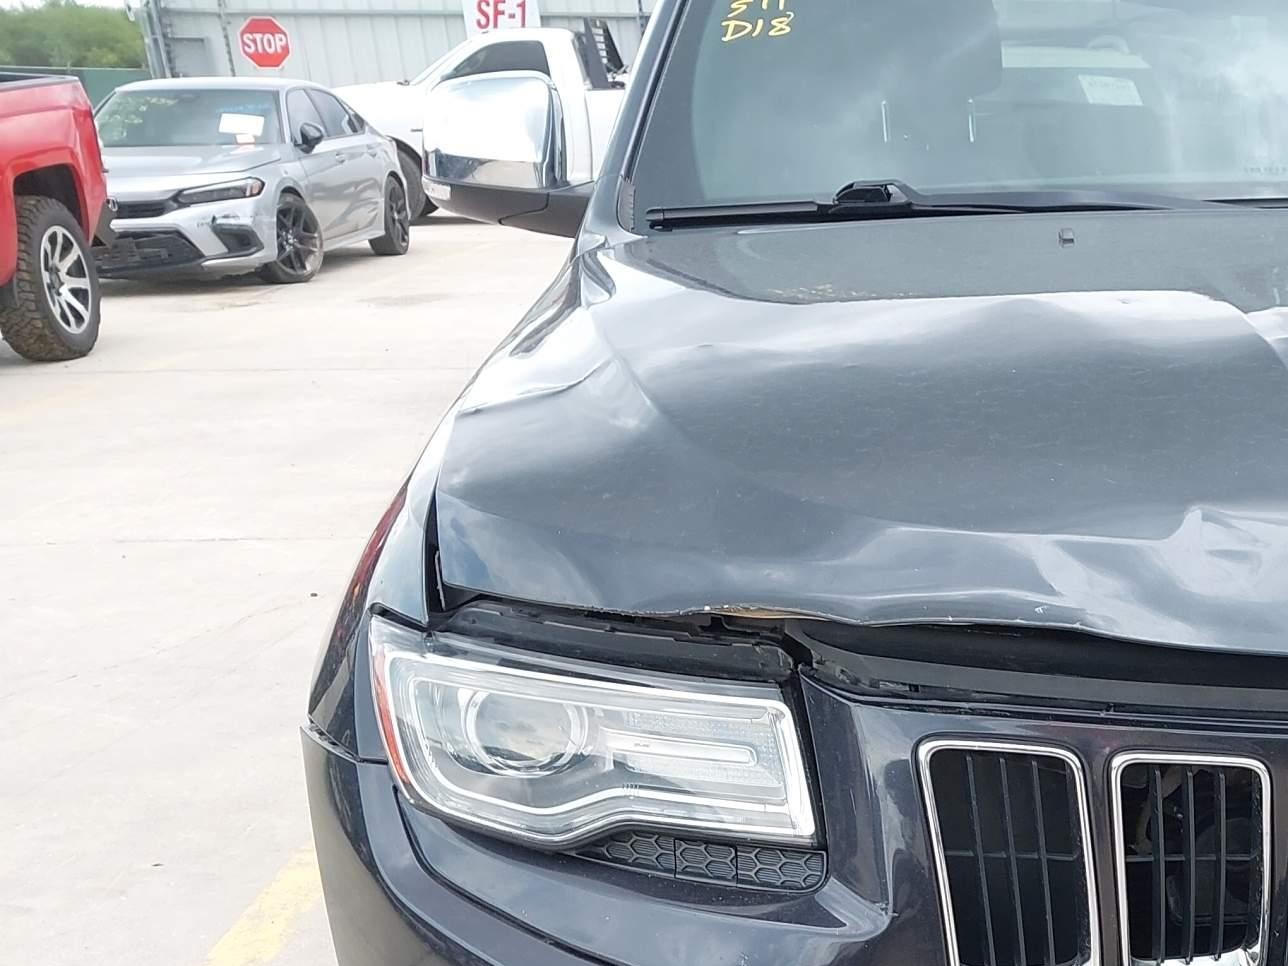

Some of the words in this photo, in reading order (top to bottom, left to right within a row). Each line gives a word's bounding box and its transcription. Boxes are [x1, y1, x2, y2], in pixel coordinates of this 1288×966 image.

[476, 0, 527, 30] SF-1
[721, 12, 795, 42] D18
[242, 32, 288, 54] STOP
